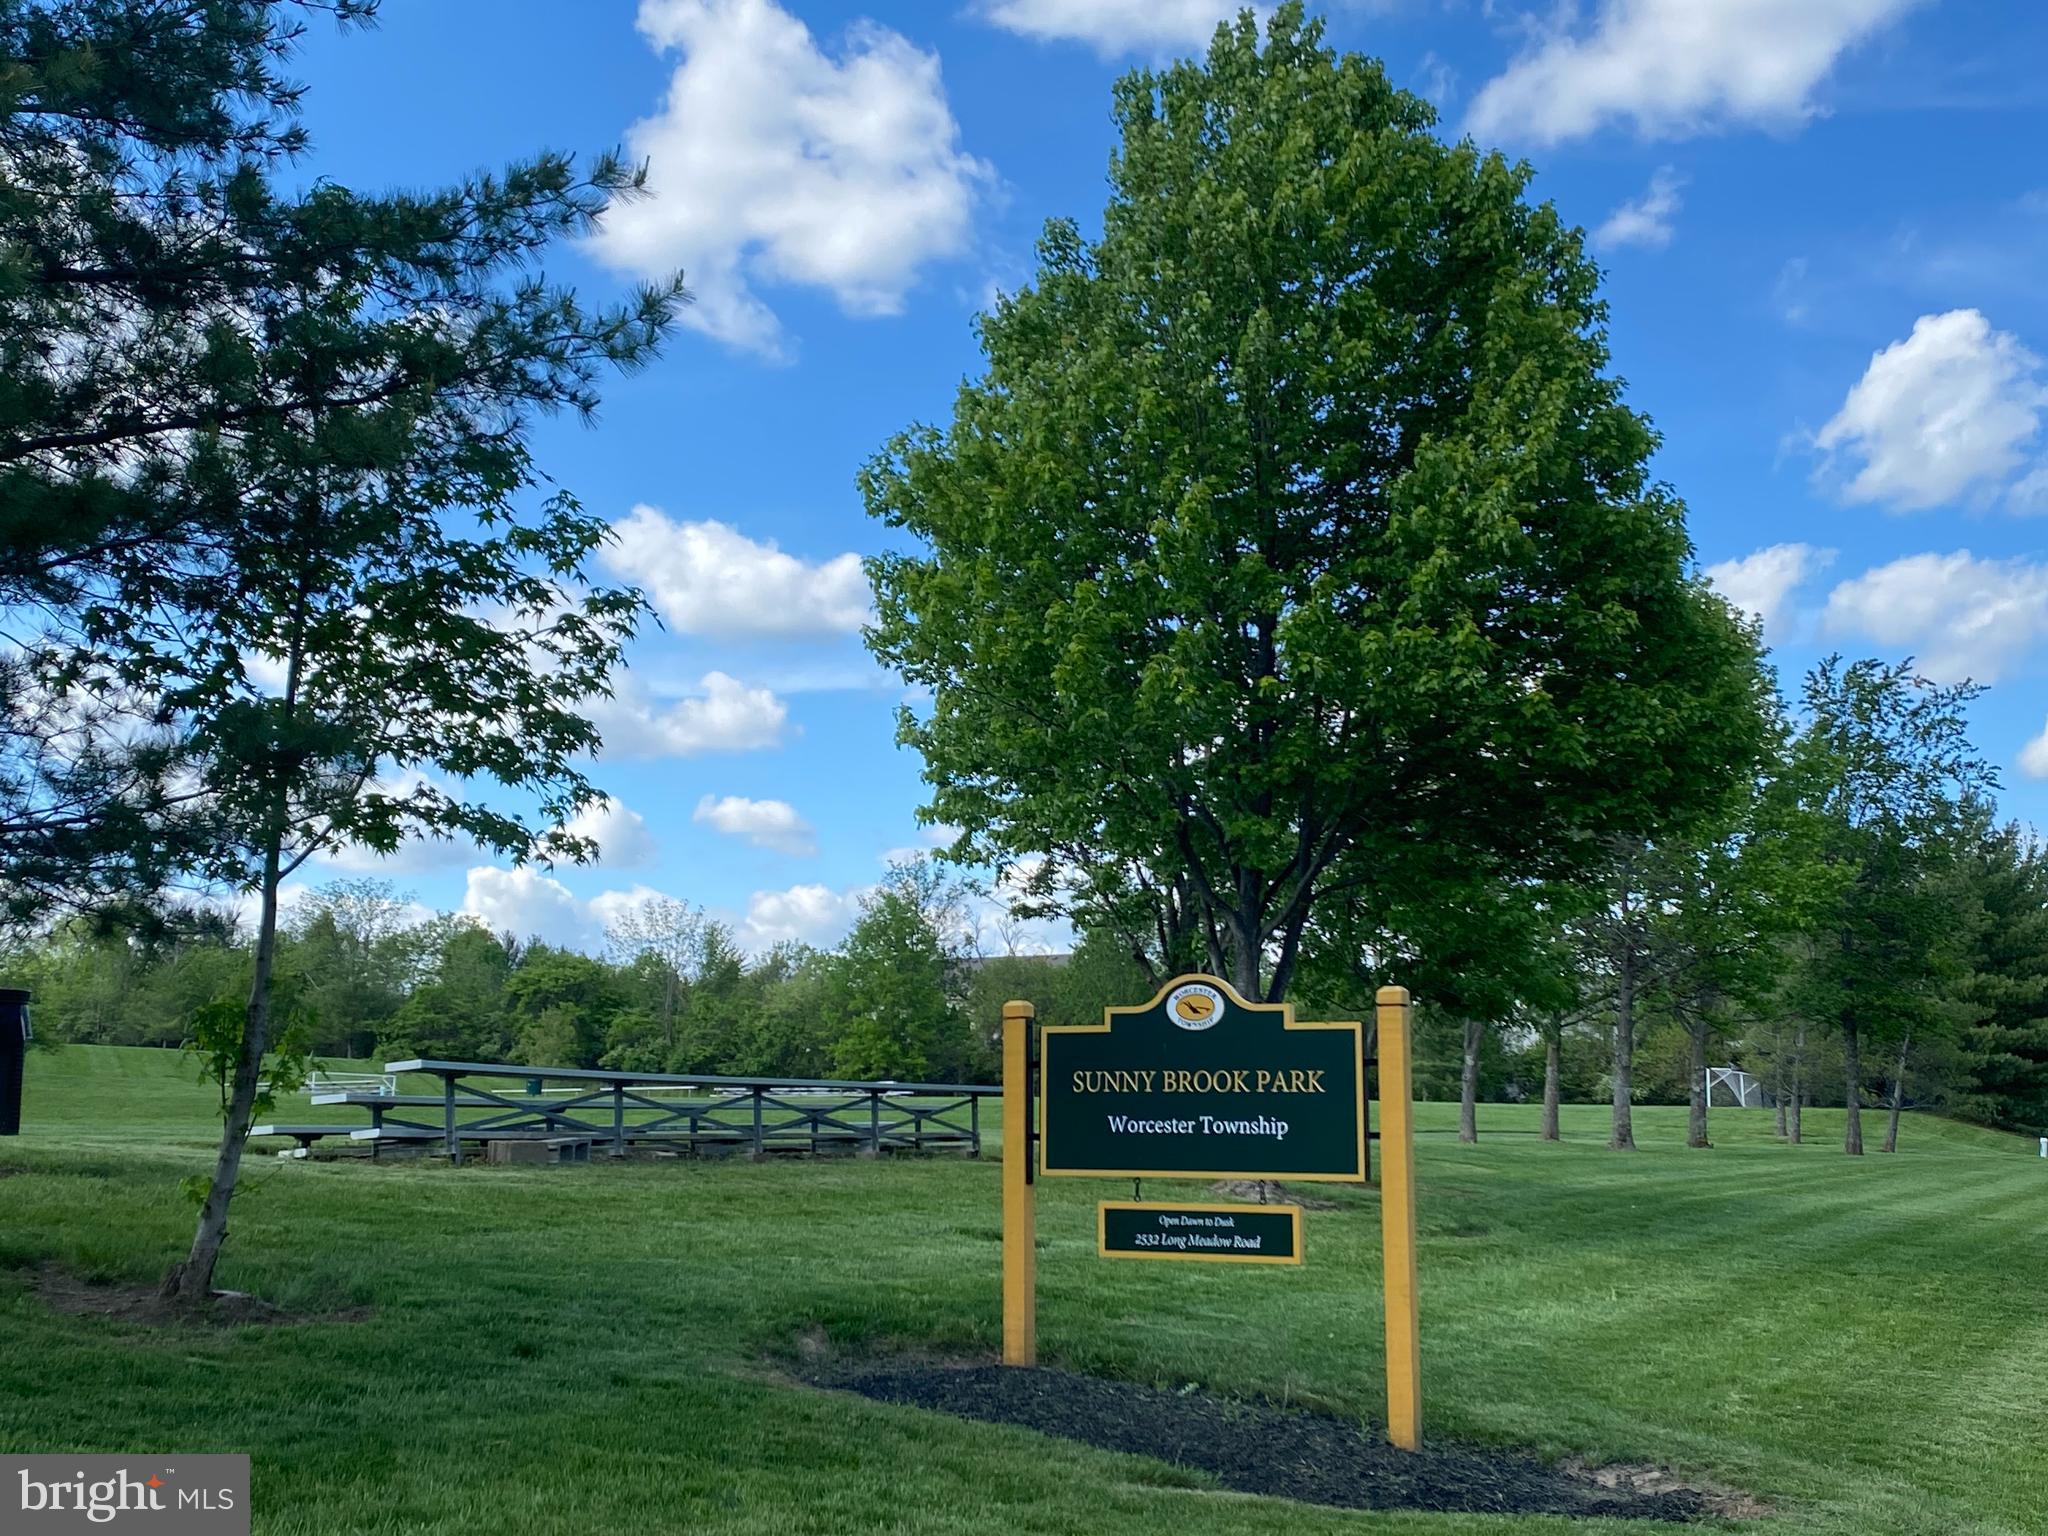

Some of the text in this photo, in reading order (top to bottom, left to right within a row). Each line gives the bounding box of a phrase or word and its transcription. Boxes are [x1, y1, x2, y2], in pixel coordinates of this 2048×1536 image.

[1072, 1070, 1326, 1094] SUNNY BROOK PARK
[1108, 1115, 1289, 1140] Worcester Township
[1159, 1215, 1235, 1228] Open Dawn to Dusk
[1135, 1233, 1261, 1249] 2532 Long Meadow Road
